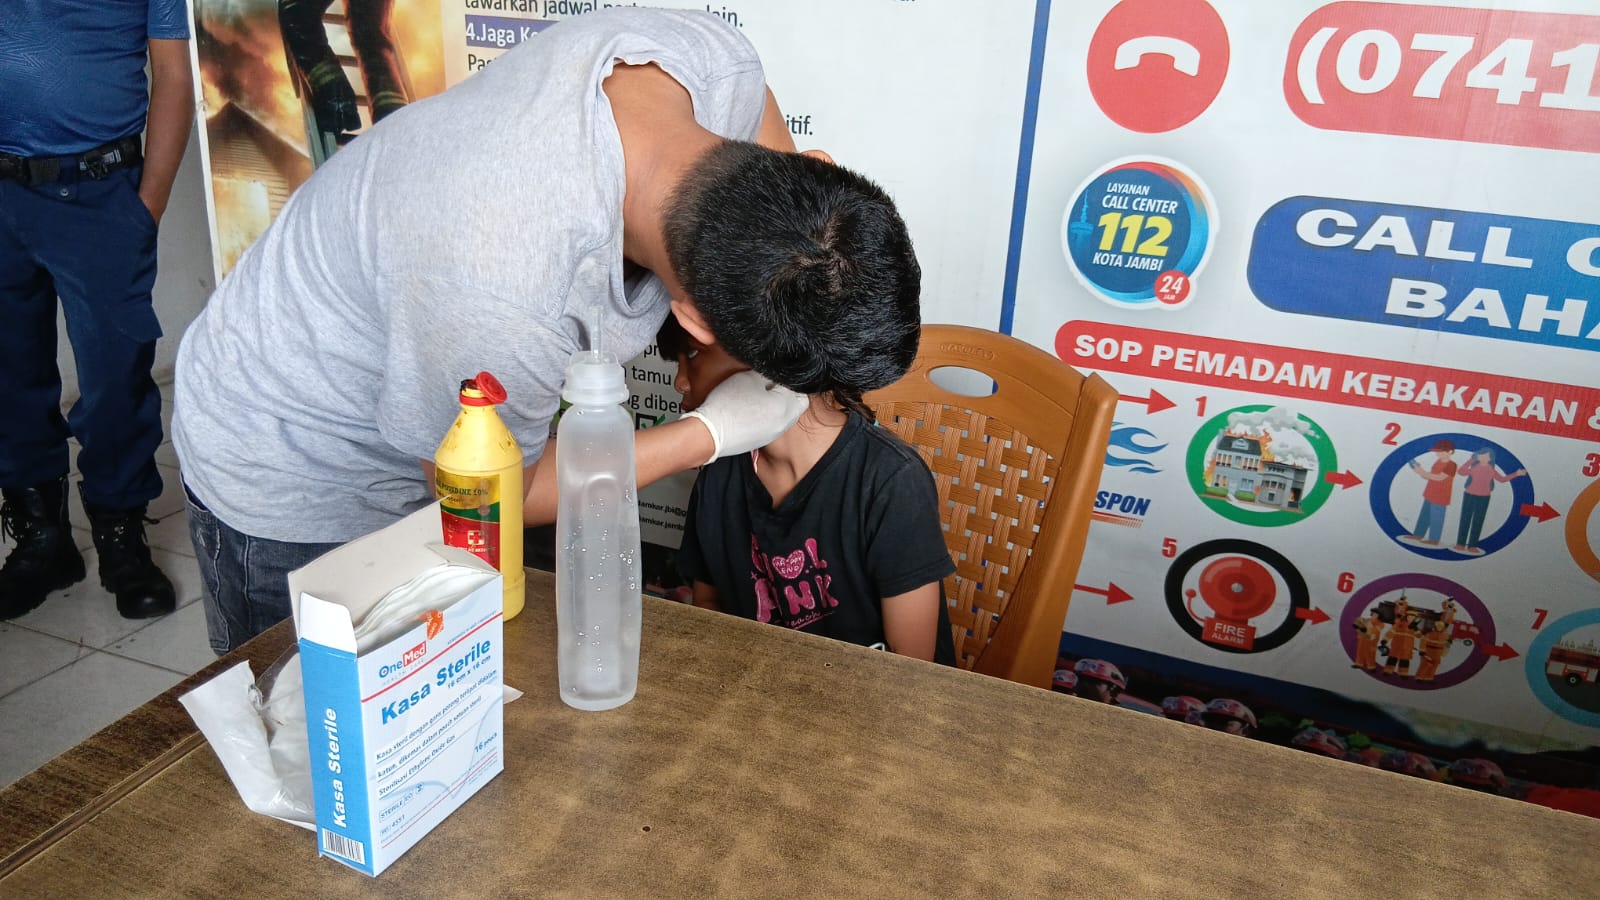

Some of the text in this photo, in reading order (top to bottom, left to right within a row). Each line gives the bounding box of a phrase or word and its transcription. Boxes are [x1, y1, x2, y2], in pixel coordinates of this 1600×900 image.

[466, 22, 516, 47] 4.Jaga
[1107, 182, 1150, 196] LAYANAN
[1102, 195, 1178, 214] CALL CENTER
[1098, 212, 1173, 256] 112
[1296, 208, 1534, 269] CALL
[1093, 252, 1163, 271] KOTA JAMBI
[1159, 275, 1184, 294] 24
[1385, 278, 1600, 340] BAH
[632, 365, 671, 386] tamu
[1074, 334, 1143, 363] SOP
[1151, 344, 1332, 391] PEMADAM
[1341, 369, 1578, 426] KEBAKARAN
[1195, 396, 1207, 417] 1
[1382, 422, 1402, 446] 2
[1162, 537, 1178, 558] 5
[1337, 571, 1355, 593] 6
[1214, 622, 1247, 637] FIRE
[1531, 608, 1548, 630] 7
[1211, 633, 1245, 645] ALARM
[379, 641, 426, 678] OneMed
[381, 640, 491, 725] Kasa Sterile
[376, 748, 392, 759] Kasa
[323, 707, 347, 828] Kasa Sterile
